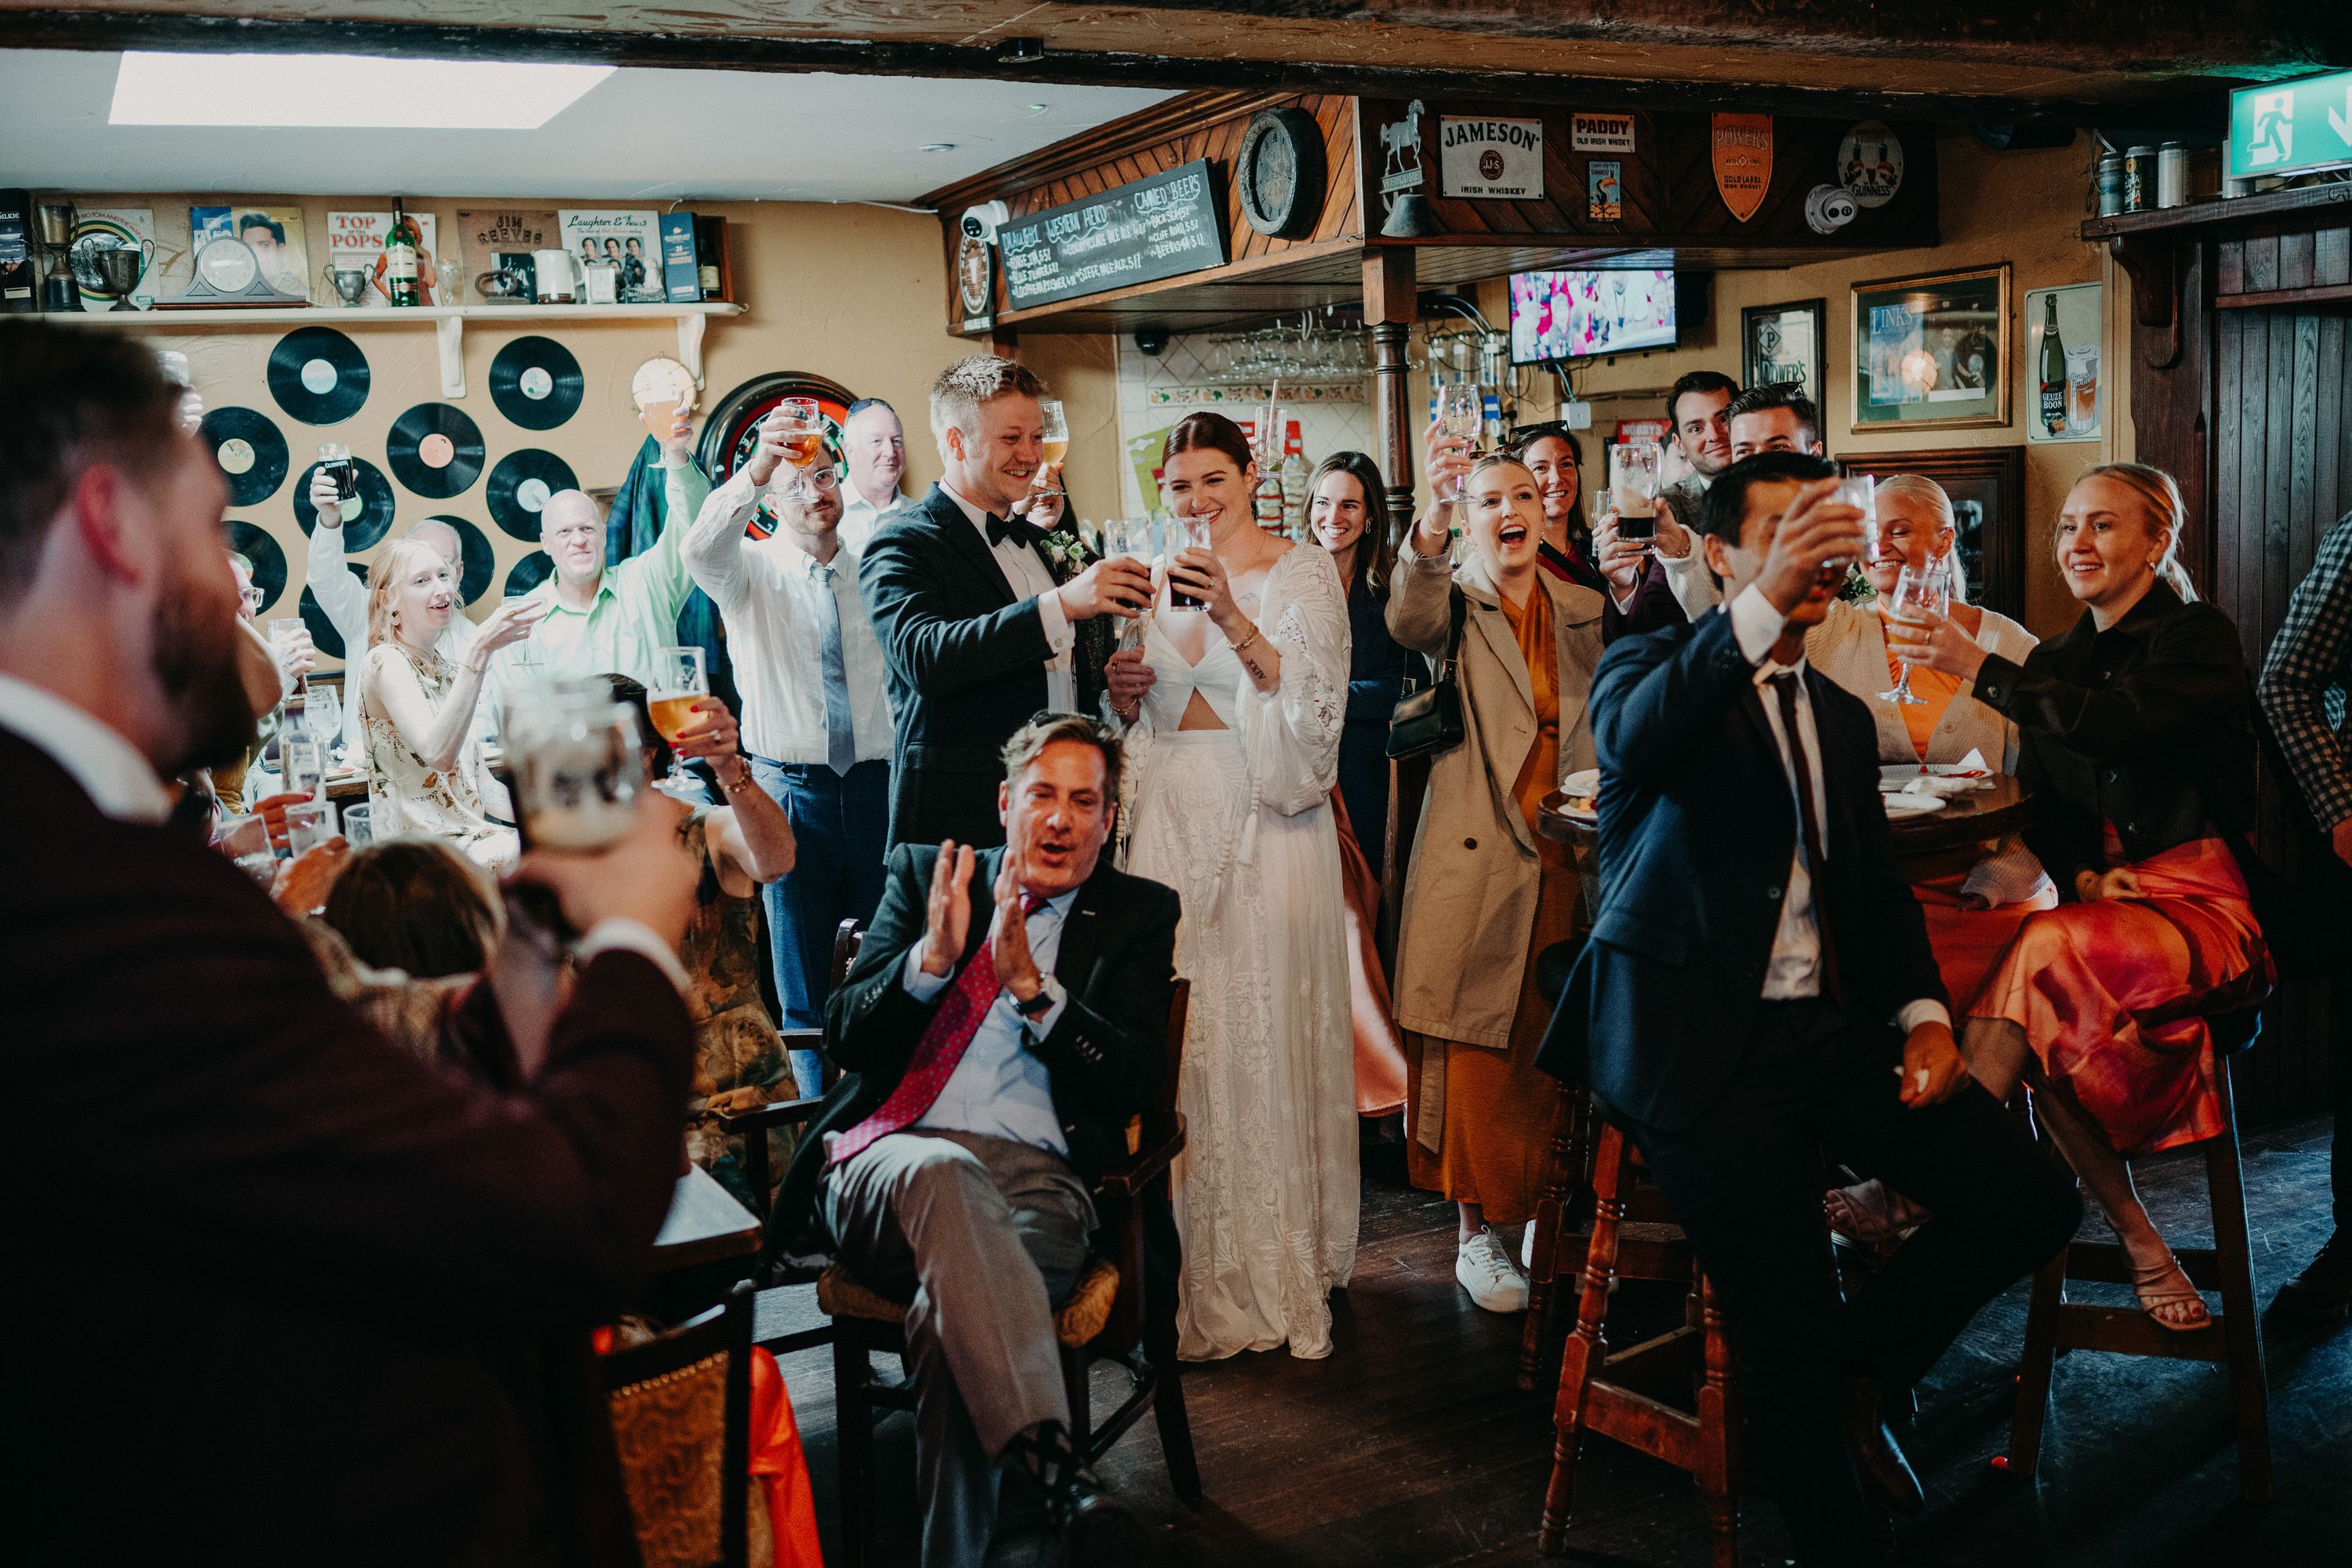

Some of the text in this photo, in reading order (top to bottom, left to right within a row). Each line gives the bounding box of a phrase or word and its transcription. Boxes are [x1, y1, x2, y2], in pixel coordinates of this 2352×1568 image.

[1576, 118, 1630, 135] PADDY
[1445, 122, 1535, 151] JAMESON
[1716, 127, 1768, 151] POWERS
[1724, 175, 1740, 183] GOLD
[1169, 174, 1200, 200] BEERS
[1488, 187, 1526, 195] WHISKEY
[1852, 183, 1890, 196] GUINNESS
[336, 215, 377, 230] TOP
[497, 213, 523, 227] JIM
[568, 215, 612, 229] Laughter
[330, 234, 383, 249] POPS
[477, 227, 543, 244] REEVES
[1871, 307, 1914, 335] LINKS
[1766, 332, 1776, 348] P
[2042, 391, 2063, 401] GEUZE
[2043, 400, 2063, 409] BOON
